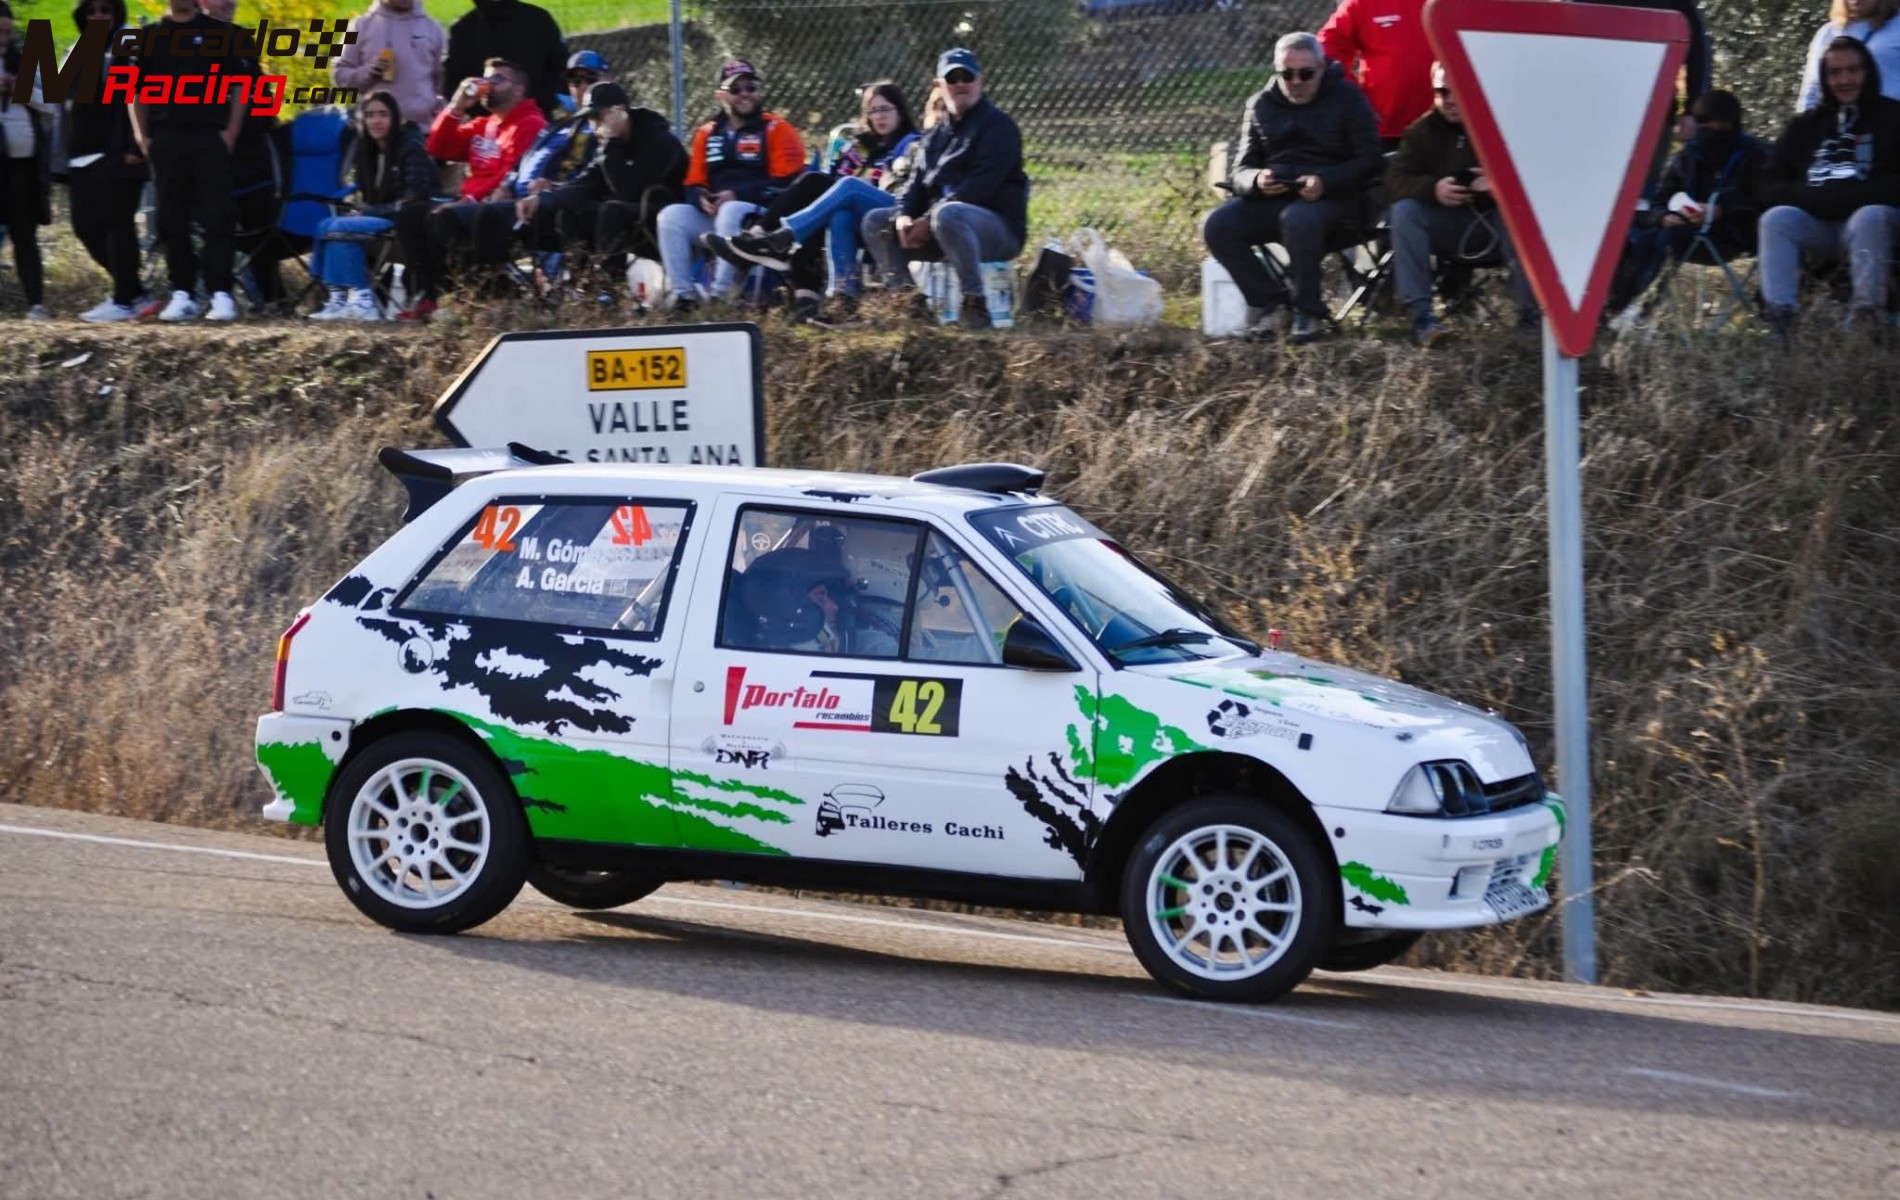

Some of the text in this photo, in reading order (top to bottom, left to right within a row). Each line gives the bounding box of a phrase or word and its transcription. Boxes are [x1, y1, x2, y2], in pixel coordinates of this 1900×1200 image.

[592, 355, 681, 383] BA-152
[589, 400, 690, 434] VALLE
[586, 446, 671, 464] SANTA
[689, 444, 743, 466] ANA
[473, 504, 521, 552] 42
[519, 537, 540, 560] M.
[515, 565, 534, 589] A.
[741, 684, 840, 710] Portalo
[889, 679, 945, 735] 42
[846, 814, 1005, 840] Talleres Cachi
